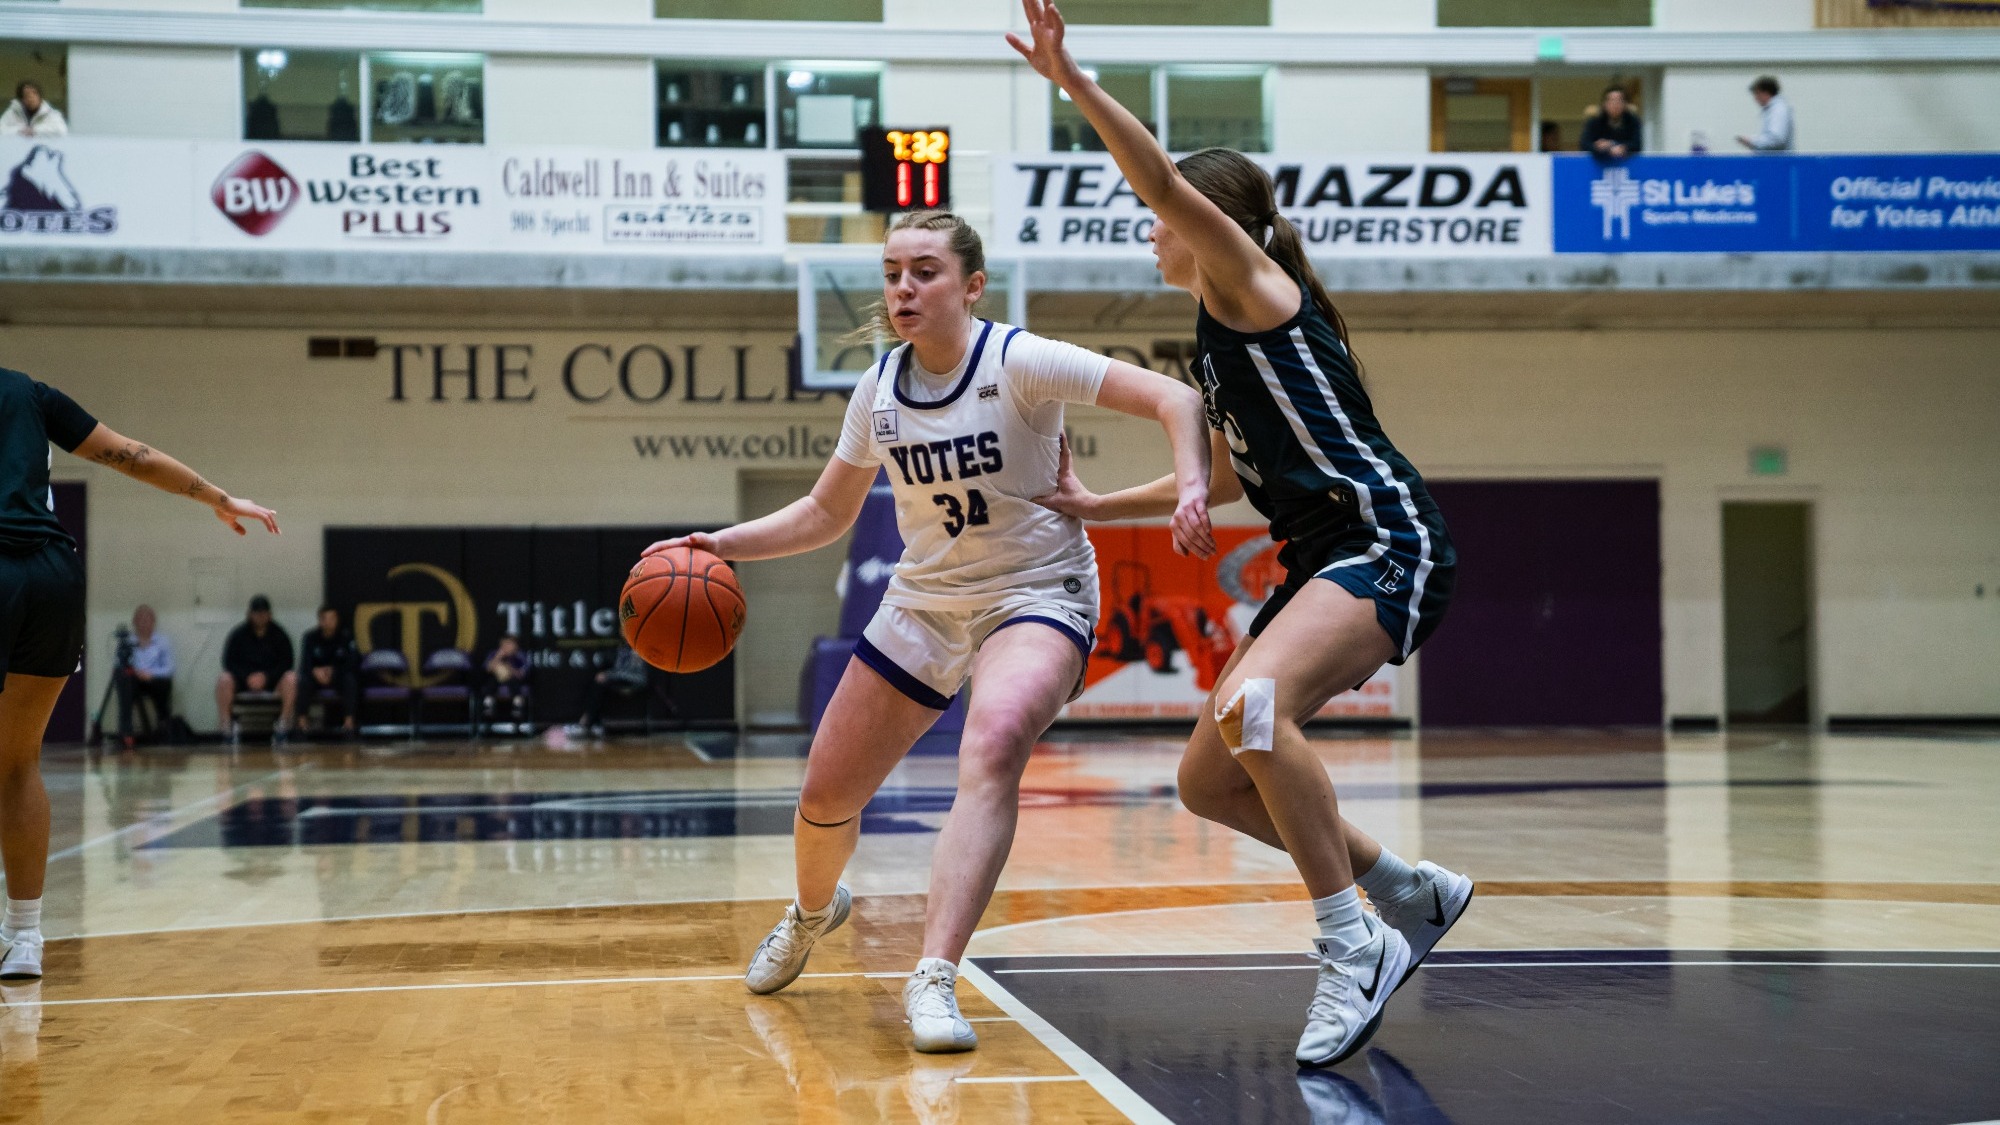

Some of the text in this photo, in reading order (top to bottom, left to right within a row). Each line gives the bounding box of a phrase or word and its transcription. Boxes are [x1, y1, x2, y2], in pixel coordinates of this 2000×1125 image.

[350, 155, 440, 179] Best
[503, 158, 765, 198] Caldwell Inn & Suites
[897, 162, 939, 207] 11
[224, 177, 291, 214] BW
[308, 180, 480, 205] Western
[1014, 164, 1149, 208] TEA
[1831, 176, 1922, 200] Official
[342, 211, 452, 234] PLUS
[1019, 217, 1039, 243] &
[1831, 204, 1868, 228] for
[1875, 204, 1943, 228] Yotes
[378, 343, 537, 402] THE
[889, 431, 1003, 485] YOTES
[933, 489, 990, 538] 34
[1373, 559, 1405, 594] E
[496, 600, 615, 636] Title
